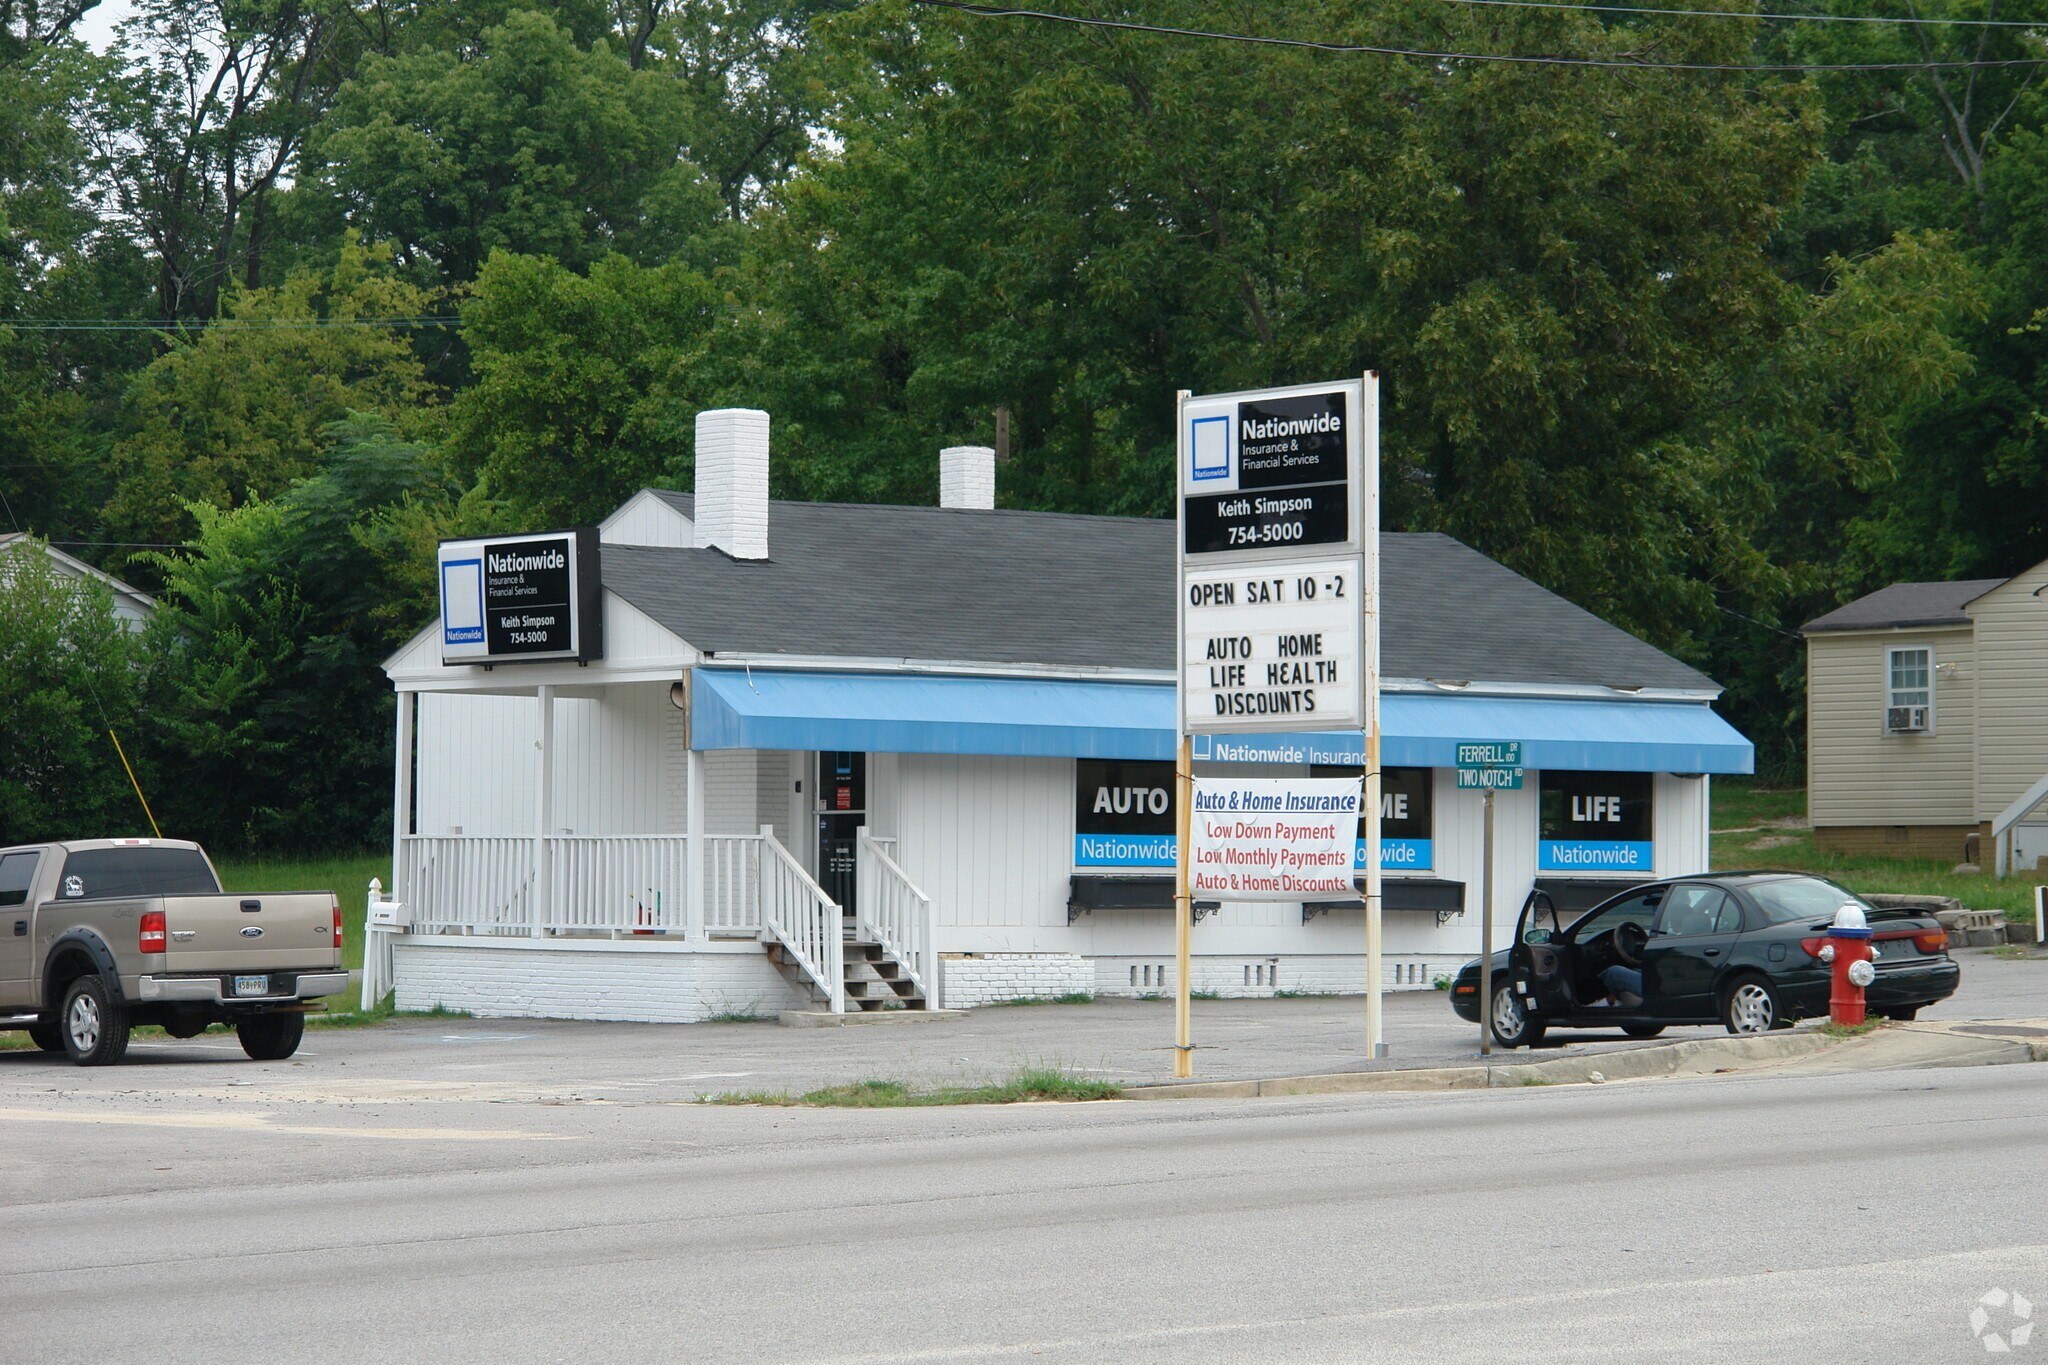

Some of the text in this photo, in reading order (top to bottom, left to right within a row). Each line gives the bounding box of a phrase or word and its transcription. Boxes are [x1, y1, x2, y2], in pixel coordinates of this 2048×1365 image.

[1242, 411, 1341, 440] Nationwide
[1242, 439, 1299, 456] Insurance &
[1242, 453, 1320, 470] Financial Services
[1195, 469, 1227, 479] Nationwide
[1217, 497, 1312, 517] Keith Simpson
[1228, 521, 1303, 545] 754-5000
[488, 549, 564, 574] Nationwide
[488, 573, 525, 586] Insurance &
[489, 585, 538, 597] Financial Services
[1190, 582, 1235, 606] OPEN
[1247, 579, 1284, 604] SAT
[501, 615, 555, 628] Keith Simpson
[447, 629, 482, 641] Nationwide
[510, 631, 548, 644] 754-5000
[1206, 633, 1322, 660] AUTO HOME
[1210, 660, 1337, 688] LIFE HEALTH
[1215, 689, 1315, 716] DISCOUNTS
[1216, 743, 1367, 765] Nationwide Insuranc
[1458, 742, 1518, 762] FERRELL DR
[1505, 752, 1515, 762] 100
[1458, 767, 1523, 787] TWO NOTCH RD
[1093, 786, 1169, 815] AUTO
[1195, 790, 1356, 811] Auto & Home Insurance
[1572, 795, 1621, 822] LIFE
[1207, 821, 1335, 844] Low Down Payment
[1082, 838, 1177, 860] Nationwide
[1197, 847, 1346, 870] Low Monthly Payments
[1552, 844, 1638, 864] Nationwide
[1195, 872, 1347, 892] Auto & Home Discounts
